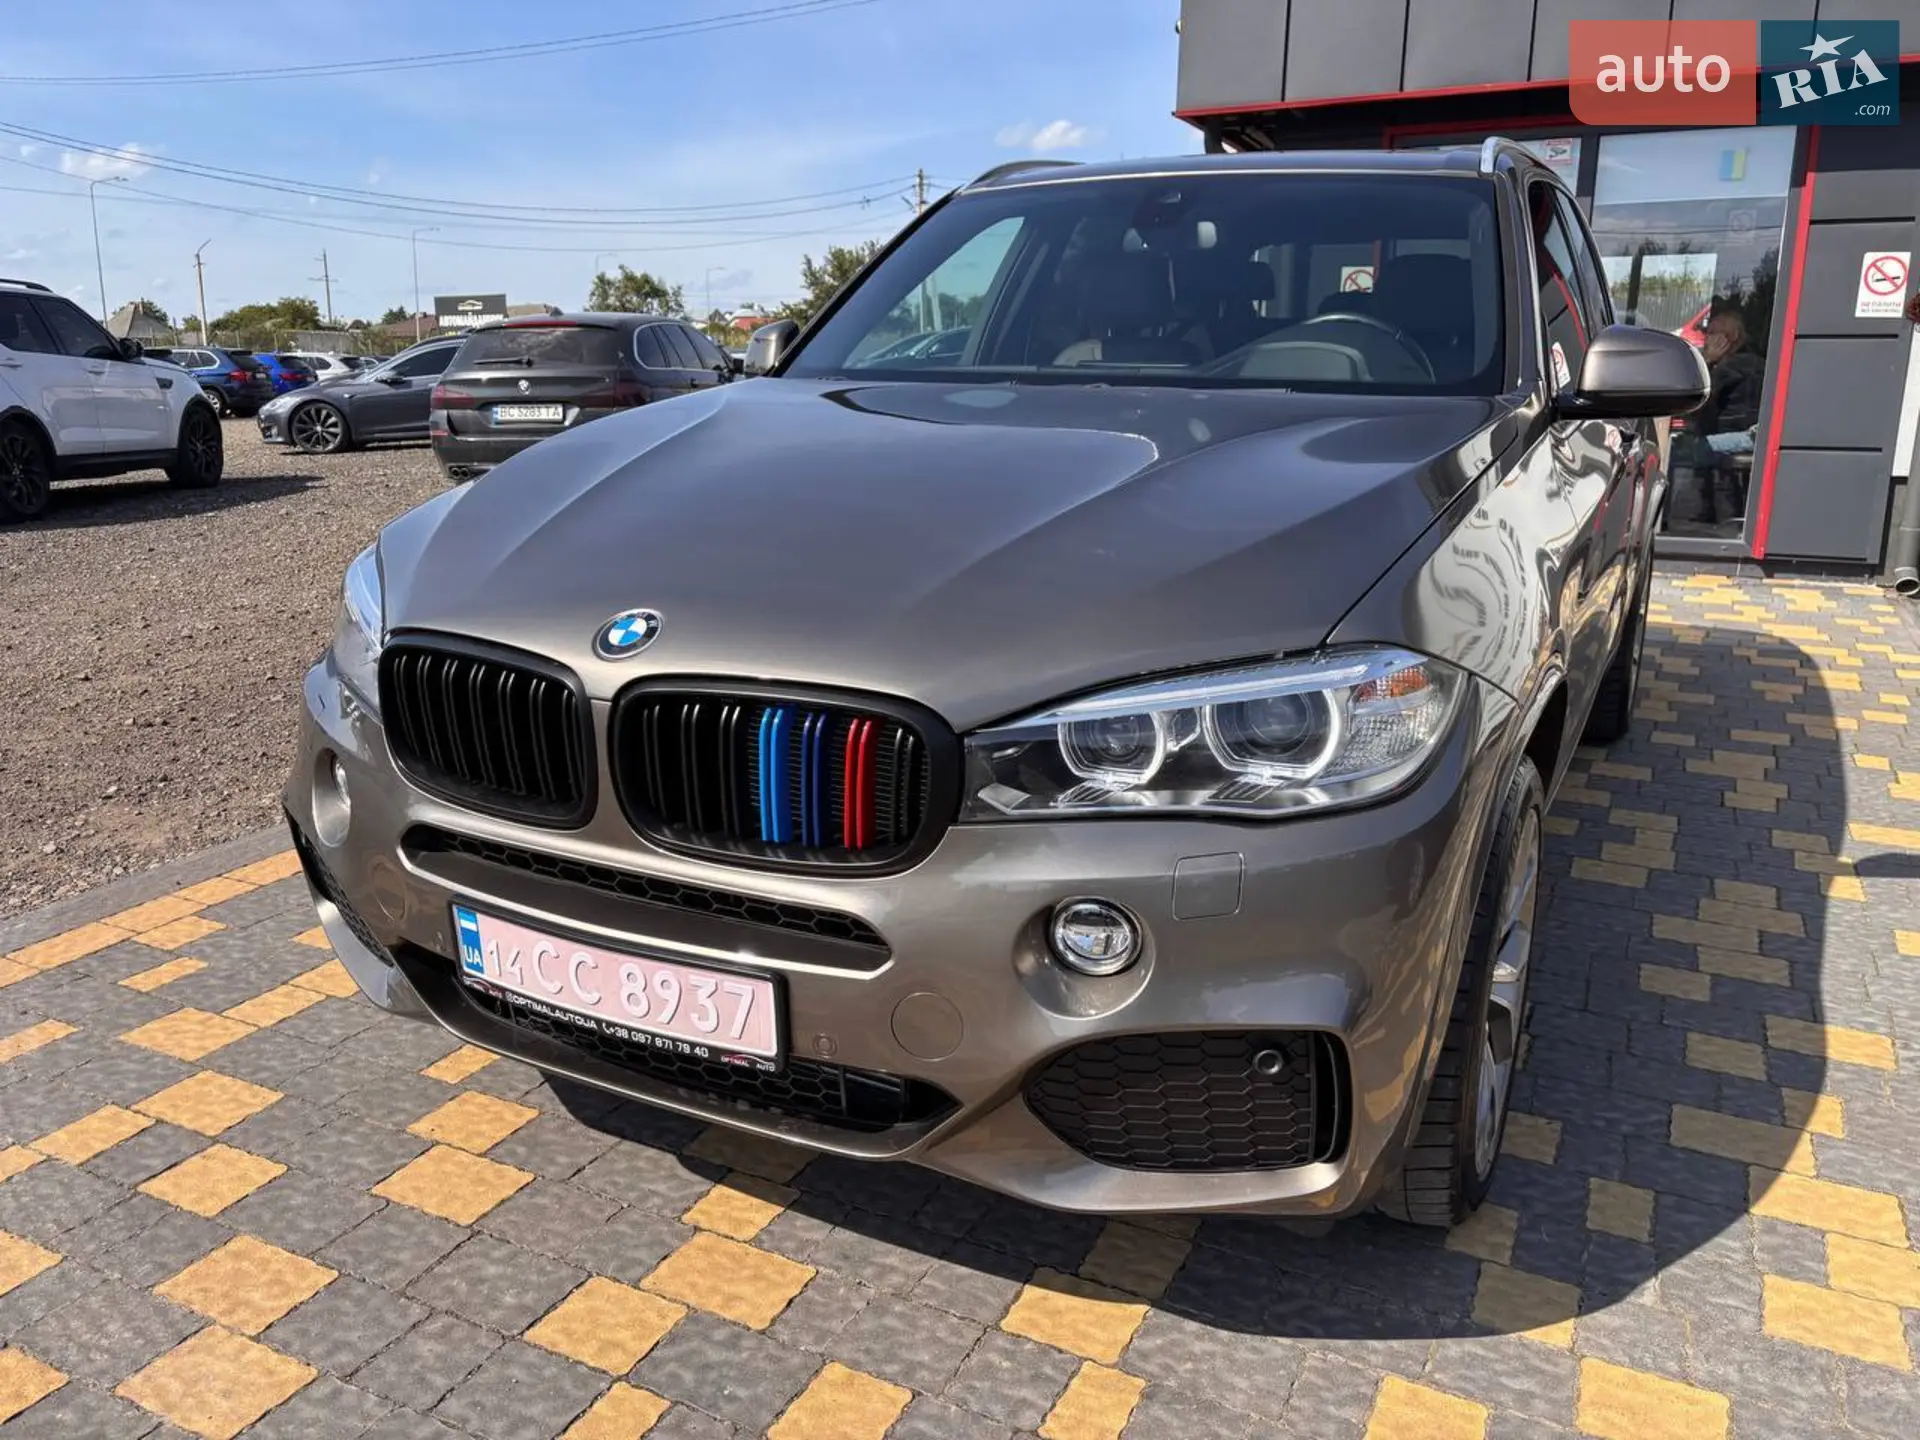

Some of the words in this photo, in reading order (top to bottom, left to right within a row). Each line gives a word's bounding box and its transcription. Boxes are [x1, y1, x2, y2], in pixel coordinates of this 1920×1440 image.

[543, 405, 561, 418] TA
[464, 944, 483, 968] UA
[618, 962, 756, 1040] 8937
[609, 1026, 629, 1039] +38
[631, 1031, 652, 1044] 097
[675, 1041, 691, 1054] 79
[694, 1046, 709, 1058] 40
